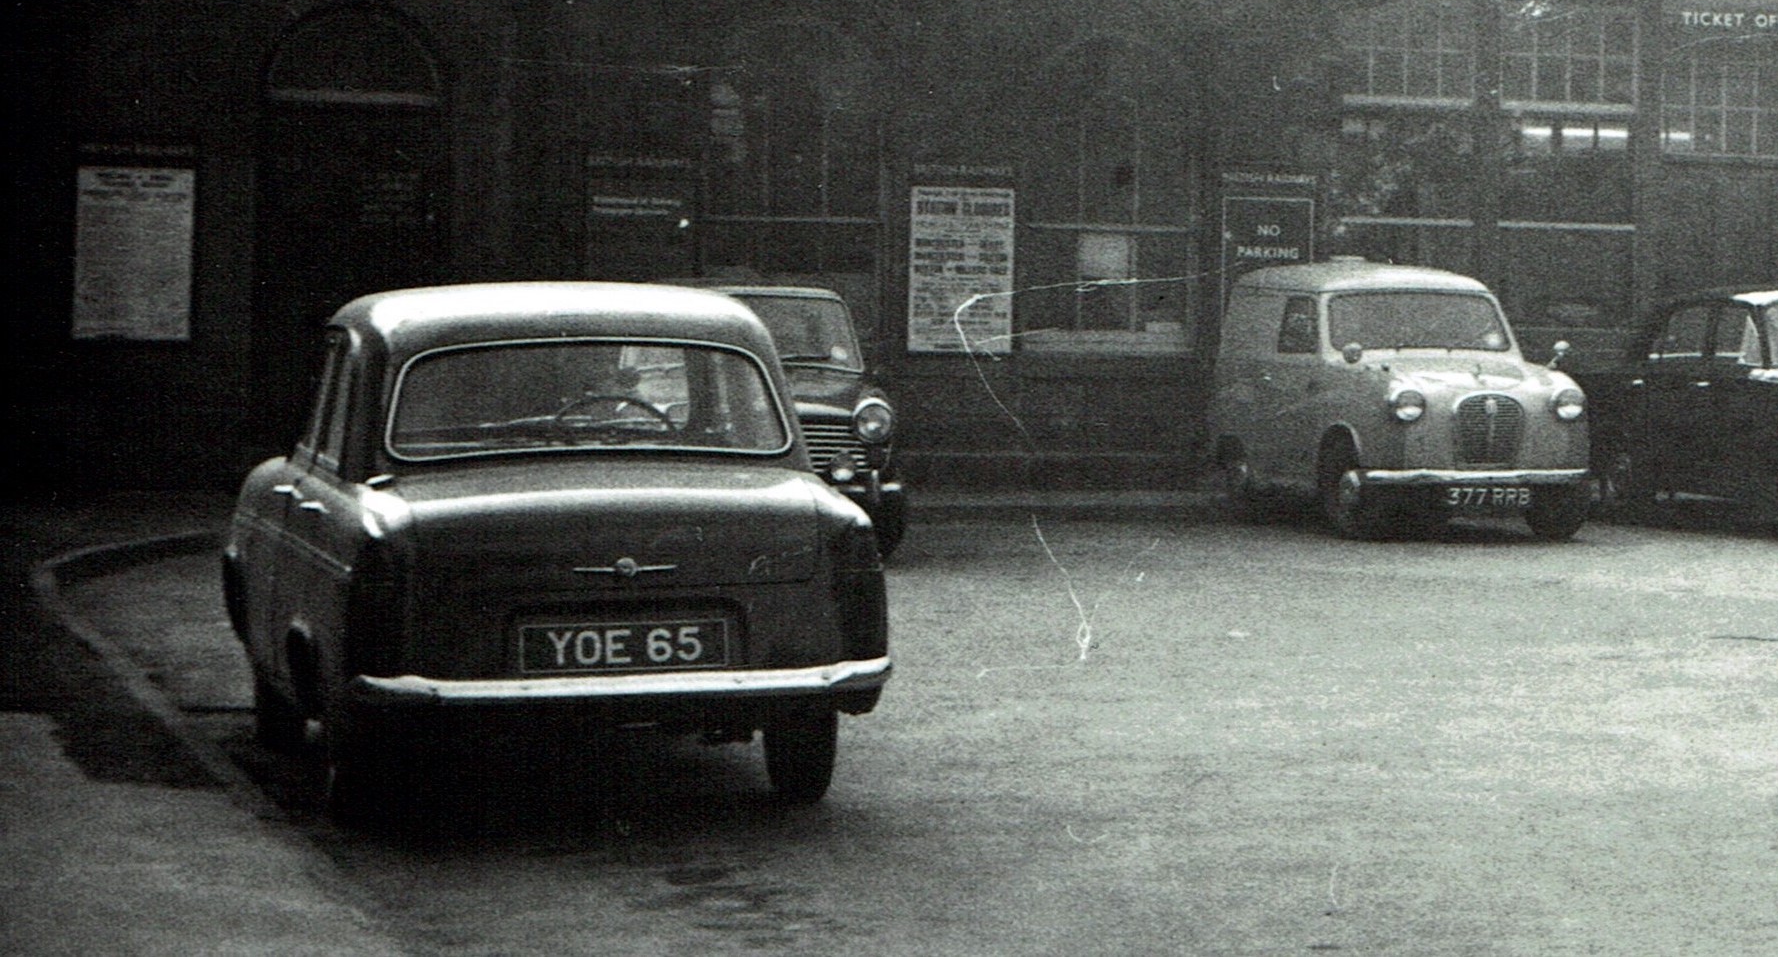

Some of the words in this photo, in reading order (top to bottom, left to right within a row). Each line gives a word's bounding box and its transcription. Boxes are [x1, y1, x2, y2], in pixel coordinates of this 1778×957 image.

[1681, 10, 1745, 27] TICKET
[1257, 225, 1281, 237] NO
[1236, 245, 1299, 260] PARKING
[1447, 487, 1487, 506] 377
[1492, 487, 1530, 506] RRB
[548, 629, 632, 665] YOE
[647, 626, 703, 663] 65
